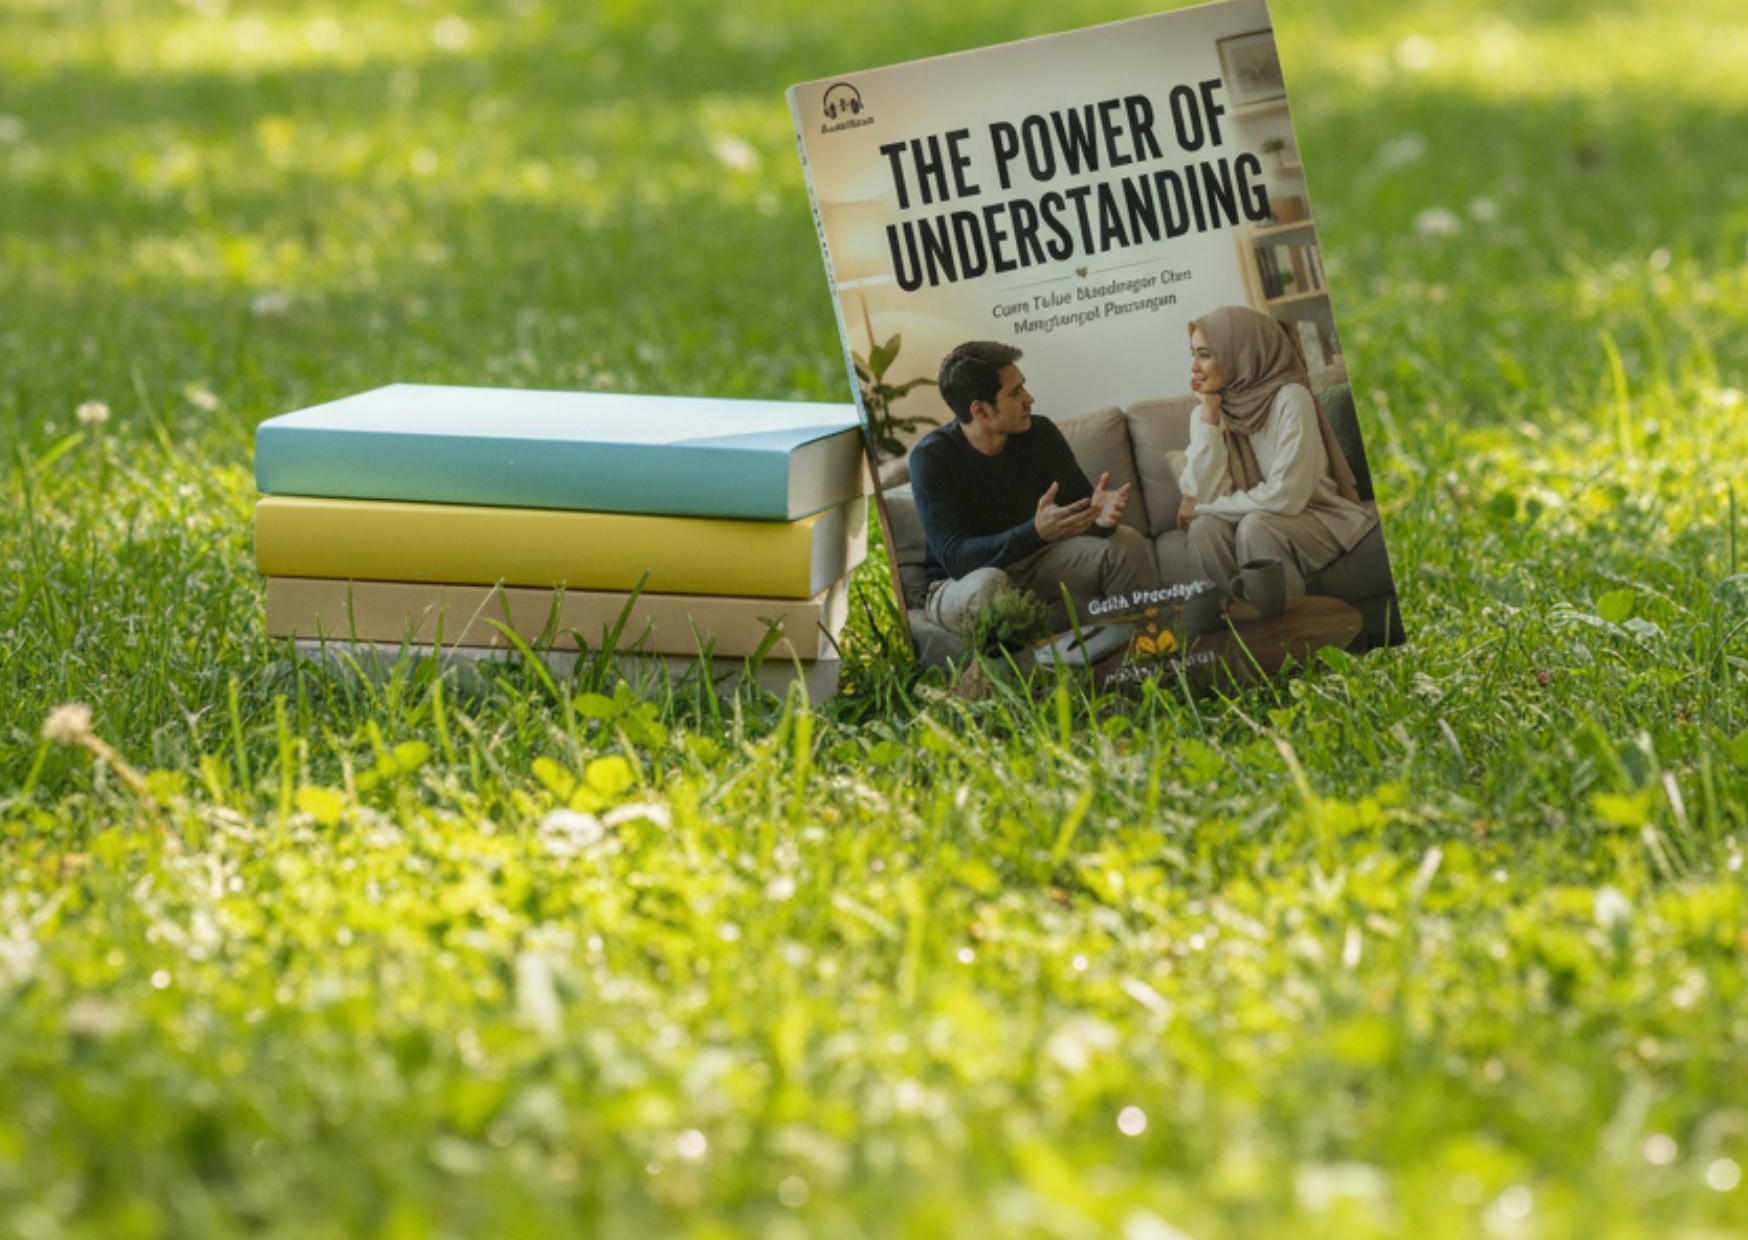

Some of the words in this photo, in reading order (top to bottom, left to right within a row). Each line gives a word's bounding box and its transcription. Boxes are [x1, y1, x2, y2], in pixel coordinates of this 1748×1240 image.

[880, 128, 981, 210] THE
[988, 94, 1163, 190] POWER
[1169, 78, 1226, 152] OF
[886, 152, 1271, 292] UNDERSTANDING
